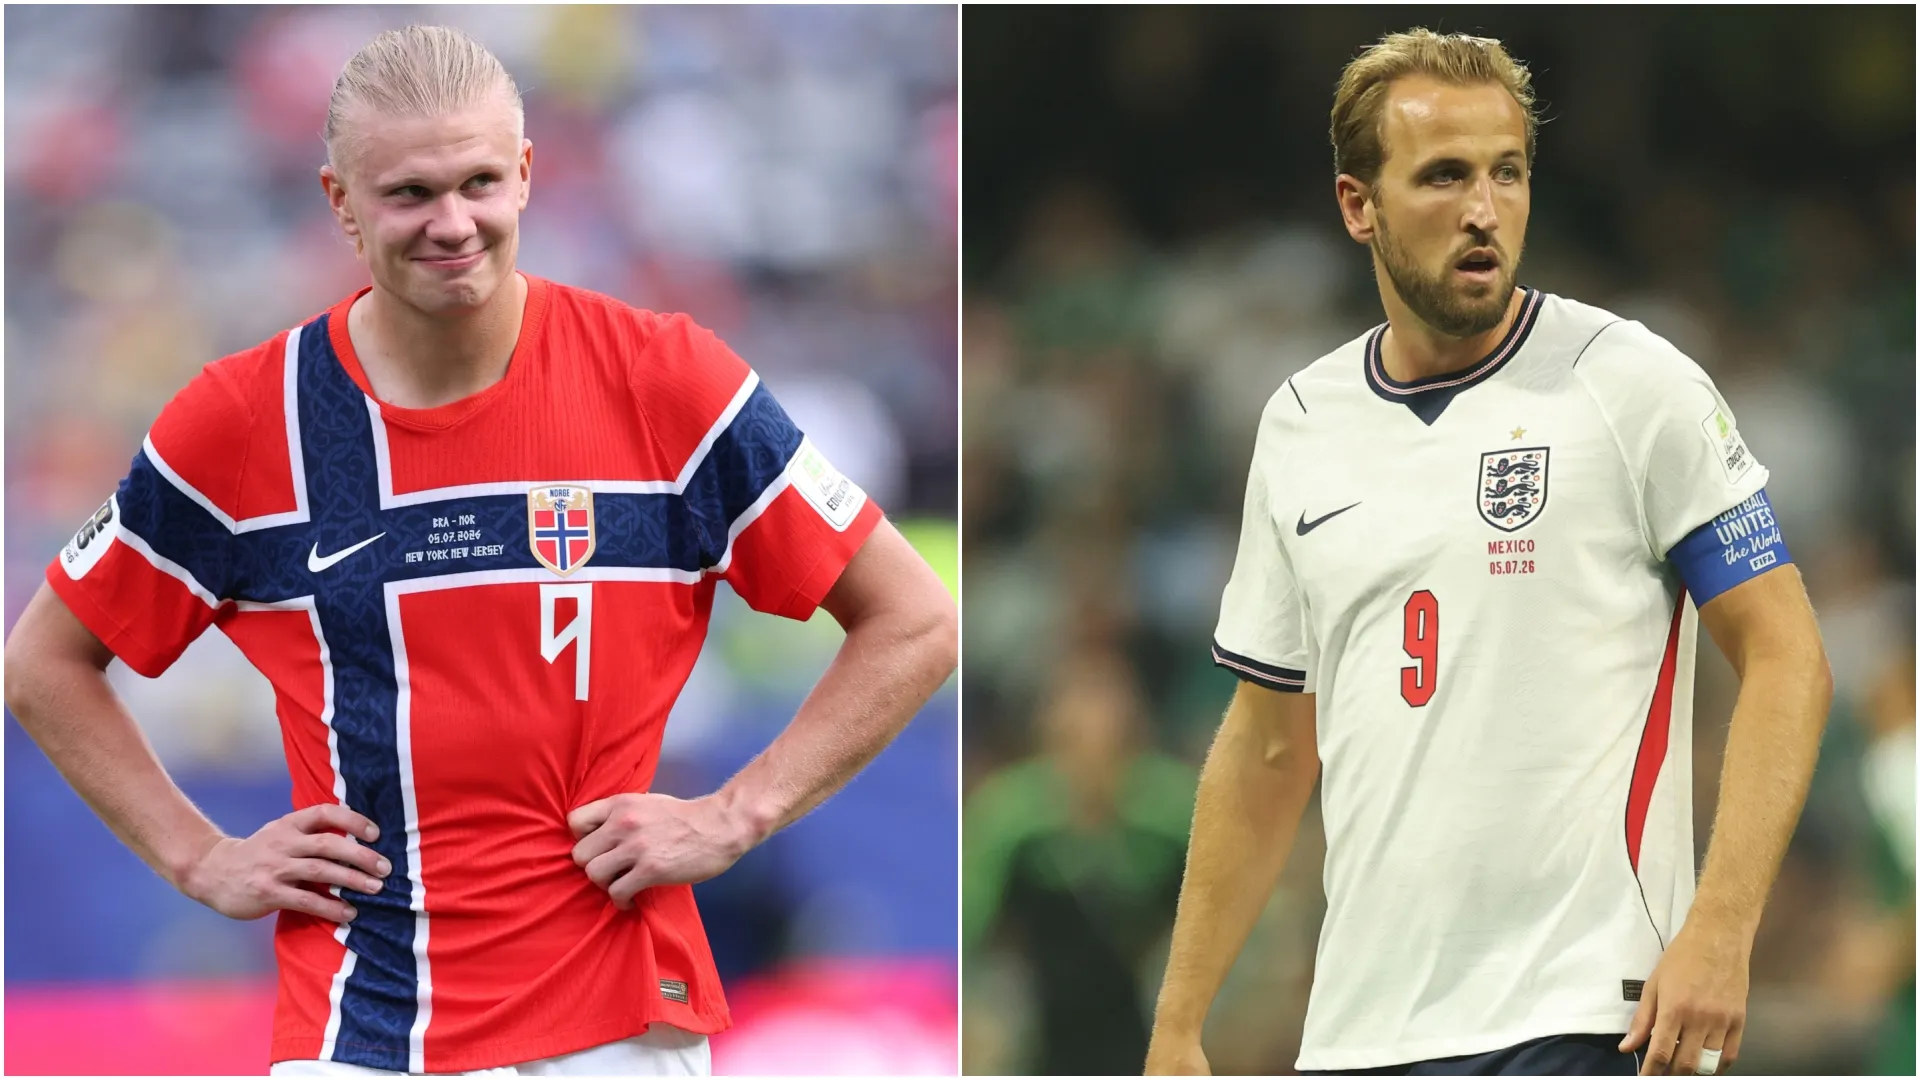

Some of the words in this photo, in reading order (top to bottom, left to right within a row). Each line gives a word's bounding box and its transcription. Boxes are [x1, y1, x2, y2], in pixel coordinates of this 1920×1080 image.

[550, 489, 569, 497] NORGE
[433, 517, 449, 528] BRA
[459, 514, 475, 526] NOR
[1716, 507, 1775, 545] UNITES
[428, 530, 481, 544] 05.07.2026
[406, 551, 424, 563] NEW
[426, 549, 449, 561] YORK
[451, 547, 469, 559] NEW
[471, 545, 504, 557] JERSEY
[1488, 540, 1535, 555] MEXICO
[1722, 545, 1749, 565] the
[1748, 527, 1782, 553] World
[1490, 560, 1535, 575] 05.07.26
[1752, 553, 1775, 569] FIFA
[539, 583, 593, 701] 9
[1400, 589, 1439, 707] 9
